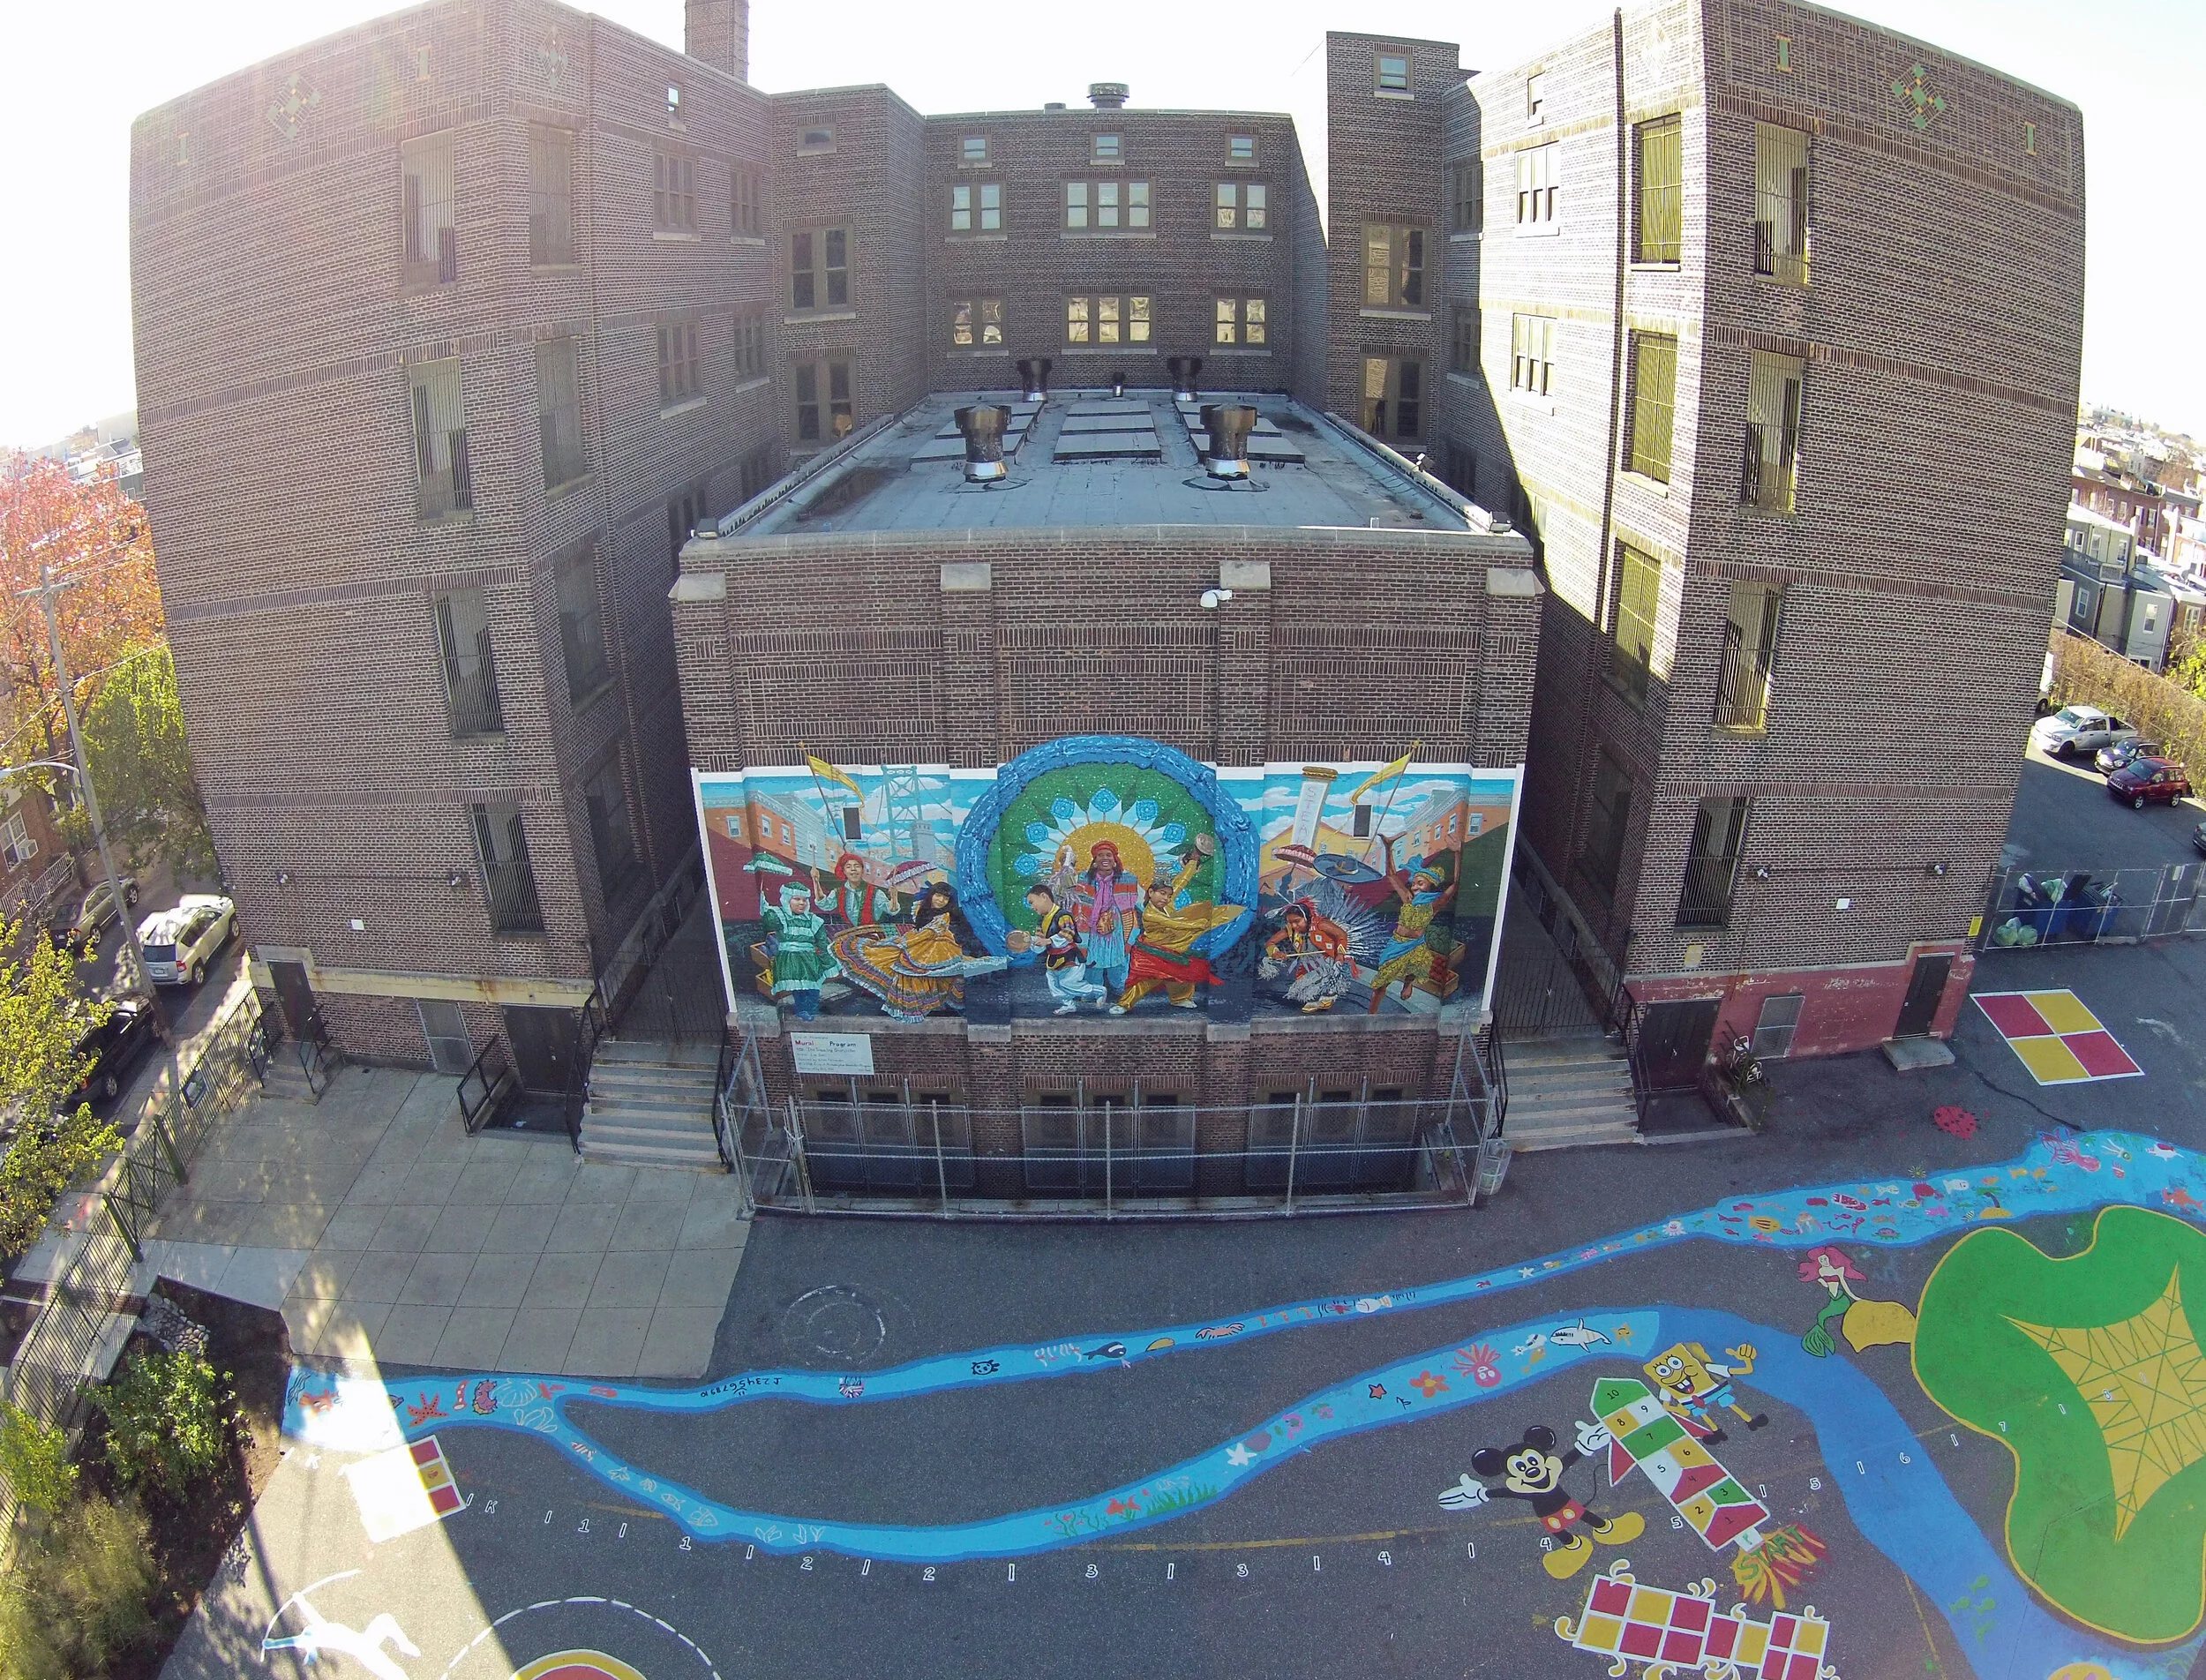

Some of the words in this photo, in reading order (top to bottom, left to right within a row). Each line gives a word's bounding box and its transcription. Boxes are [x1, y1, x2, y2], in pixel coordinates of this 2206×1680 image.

[1606, 1389, 1620, 1400] 10
[1617, 1418, 1625, 1427] 8
[1657, 1464, 1666, 1473] 5
[484, 1500, 499, 1513] K
[579, 1519, 590, 1534] 1
[679, 1536, 692, 1550] 1
[800, 1556, 814, 1571] 2
[923, 1567, 936, 1582] 2
[1085, 1564, 1099, 1579] 3
[1236, 1564, 1249, 1578] 3
[1377, 1551, 1392, 1565] 4
[1539, 1537, 1553, 1552] 4
[1670, 1516, 1684, 1529] 5
[1809, 1477, 1821, 1490] 5
[1899, 1452, 1910, 1464] 6
[1999, 1421, 2006, 1432] 7
[1694, 1506, 1704, 1515] 2
[1720, 1488, 1729, 1496] 3
[1737, 1526, 1805, 1580] START
